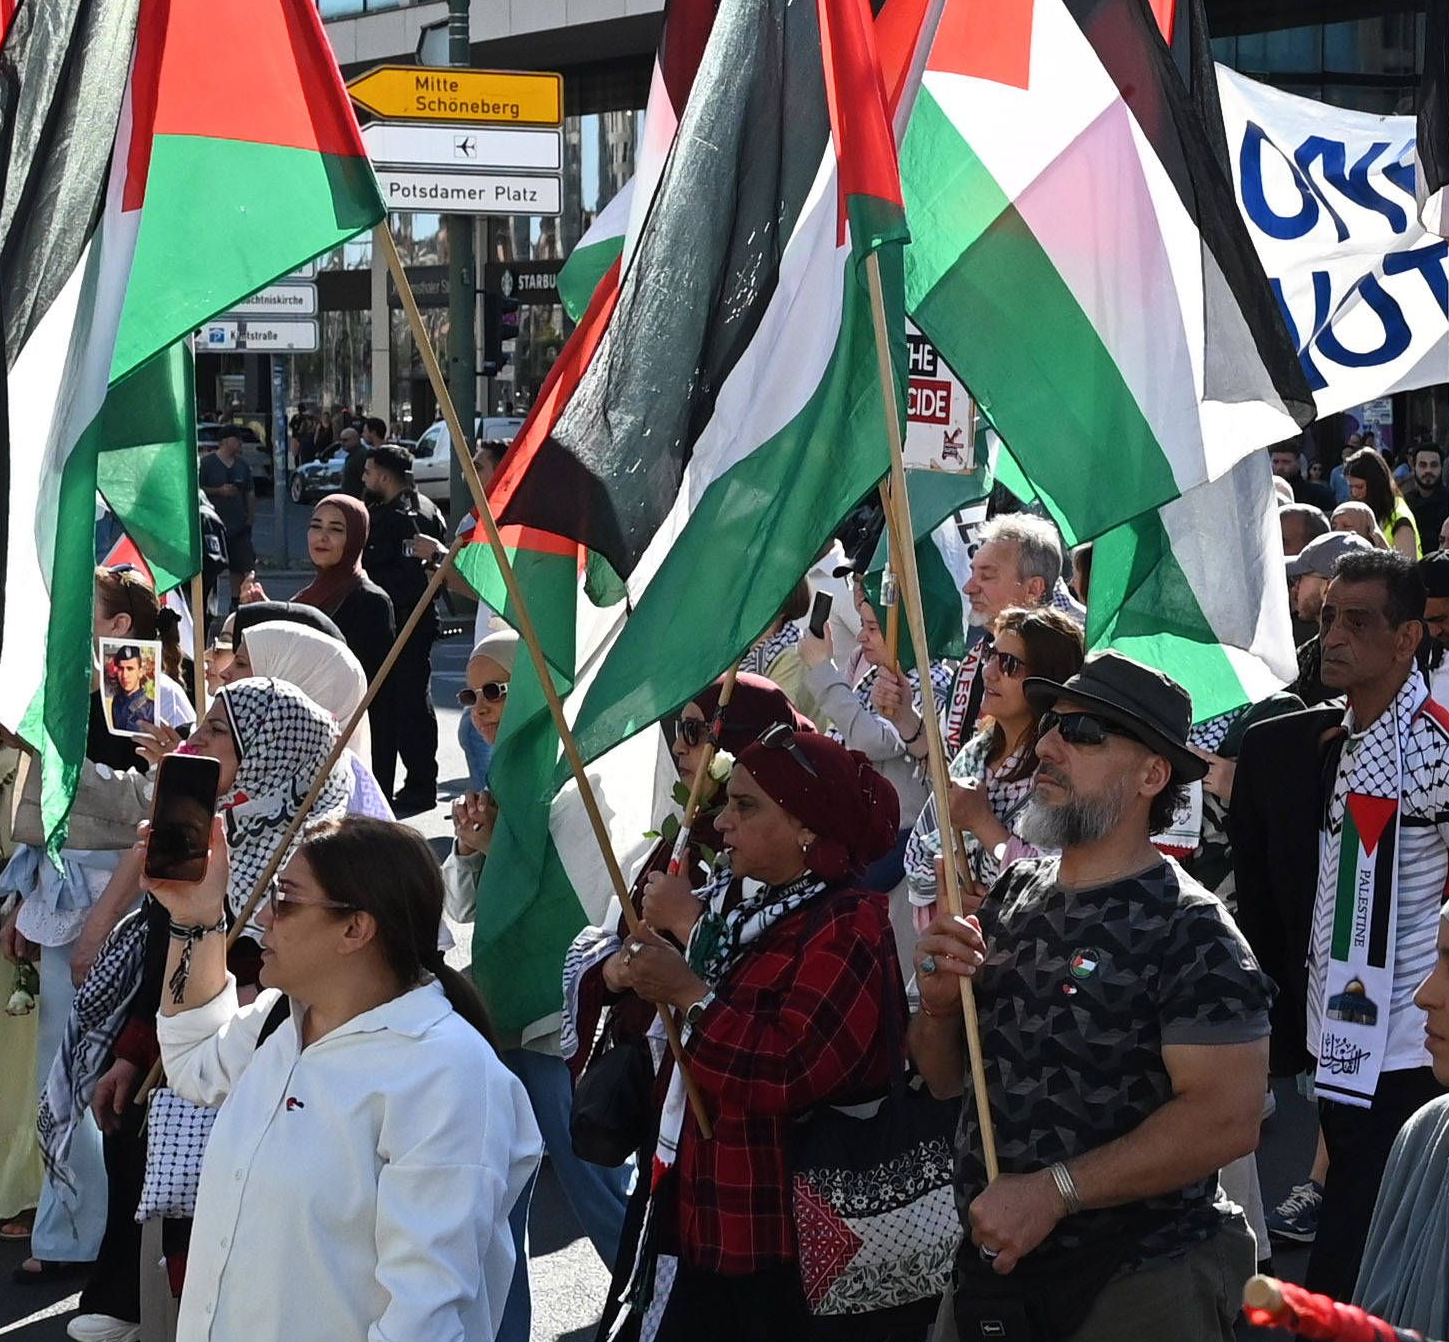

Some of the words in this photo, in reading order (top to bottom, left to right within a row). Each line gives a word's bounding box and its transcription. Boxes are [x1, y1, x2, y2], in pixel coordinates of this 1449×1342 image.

[415, 76, 459, 92] Mitte
[416, 97, 520, 119] Schöneberg
[389, 183, 485, 201] Potsdamer
[495, 186, 537, 203] Platz
[518, 274, 556, 290] STARBU
[907, 343, 934, 370] HE
[1354, 869, 1371, 948] PALESTINE
